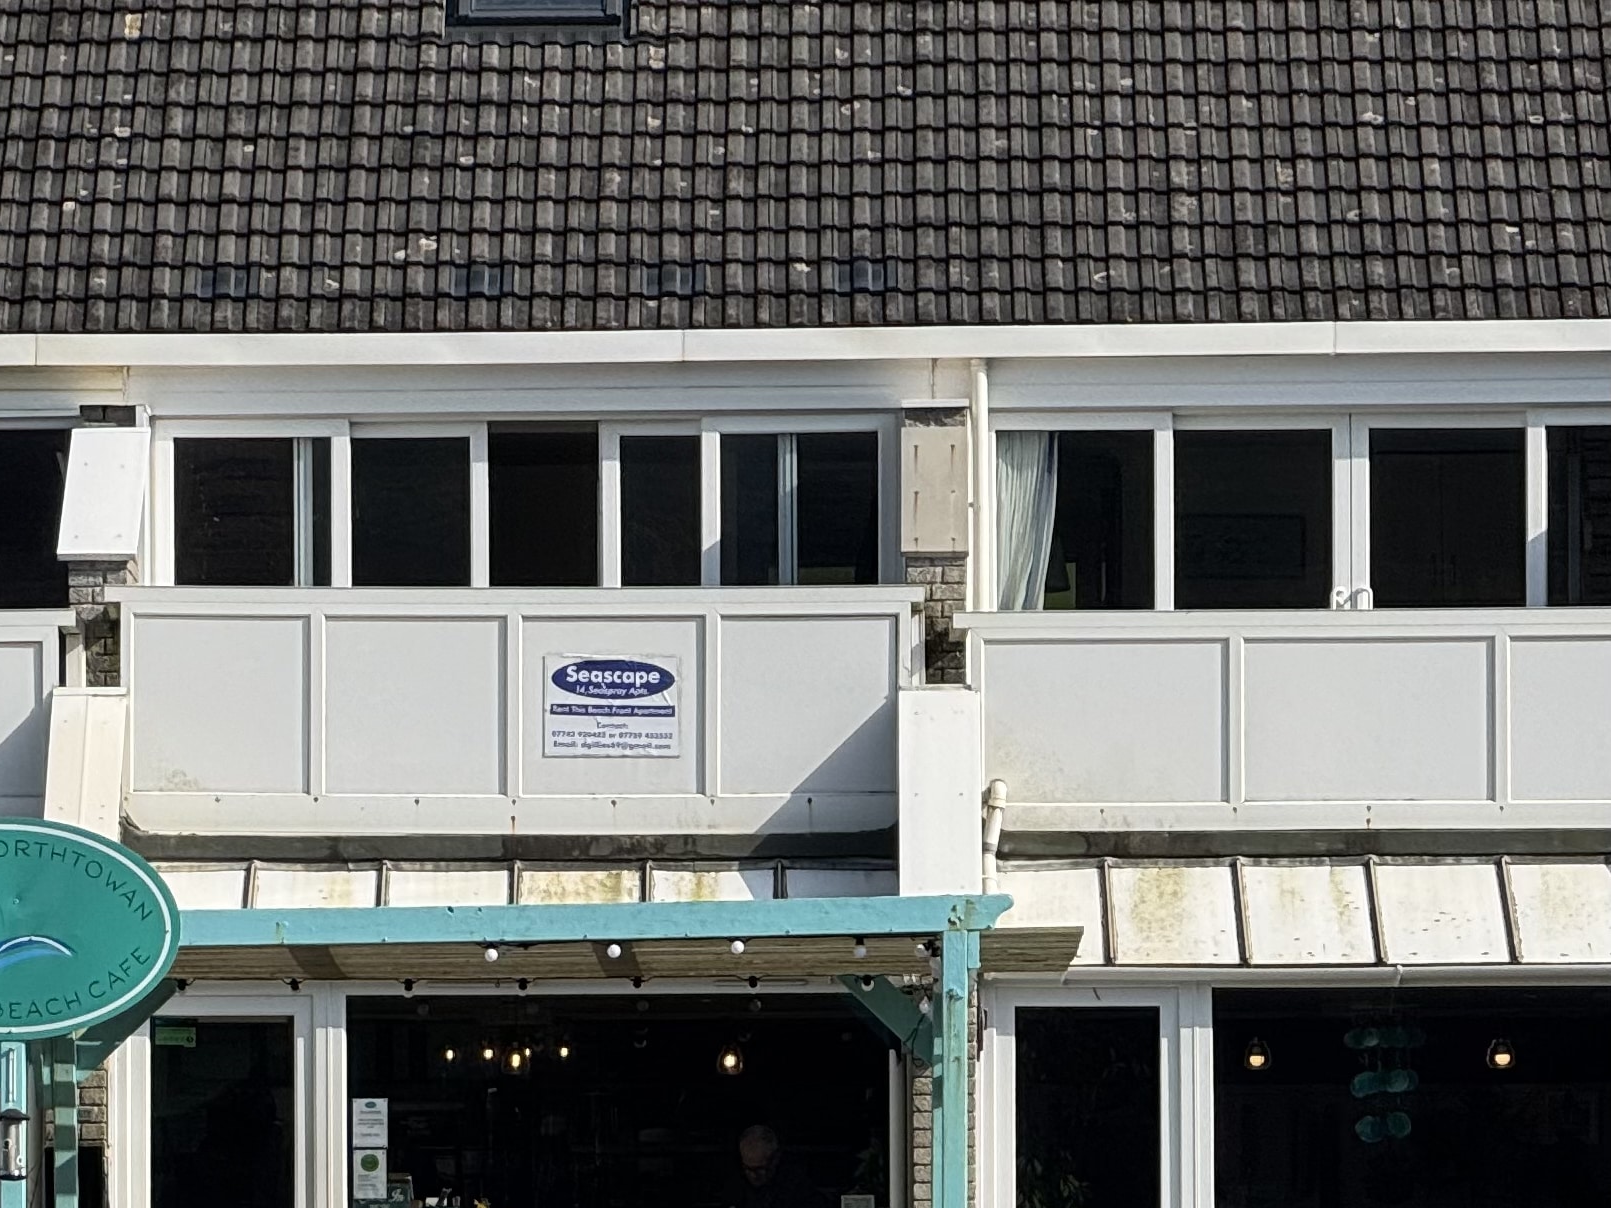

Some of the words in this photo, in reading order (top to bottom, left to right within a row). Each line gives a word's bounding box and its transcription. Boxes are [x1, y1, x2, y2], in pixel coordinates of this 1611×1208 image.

[566, 665, 661, 687] Seascape
[552, 705, 570, 713] Rent
[588, 706, 611, 714] Beach
[611, 707, 632, 715] Front
[633, 707, 673, 716] Apartment
[88, 947, 151, 999] CAFE
